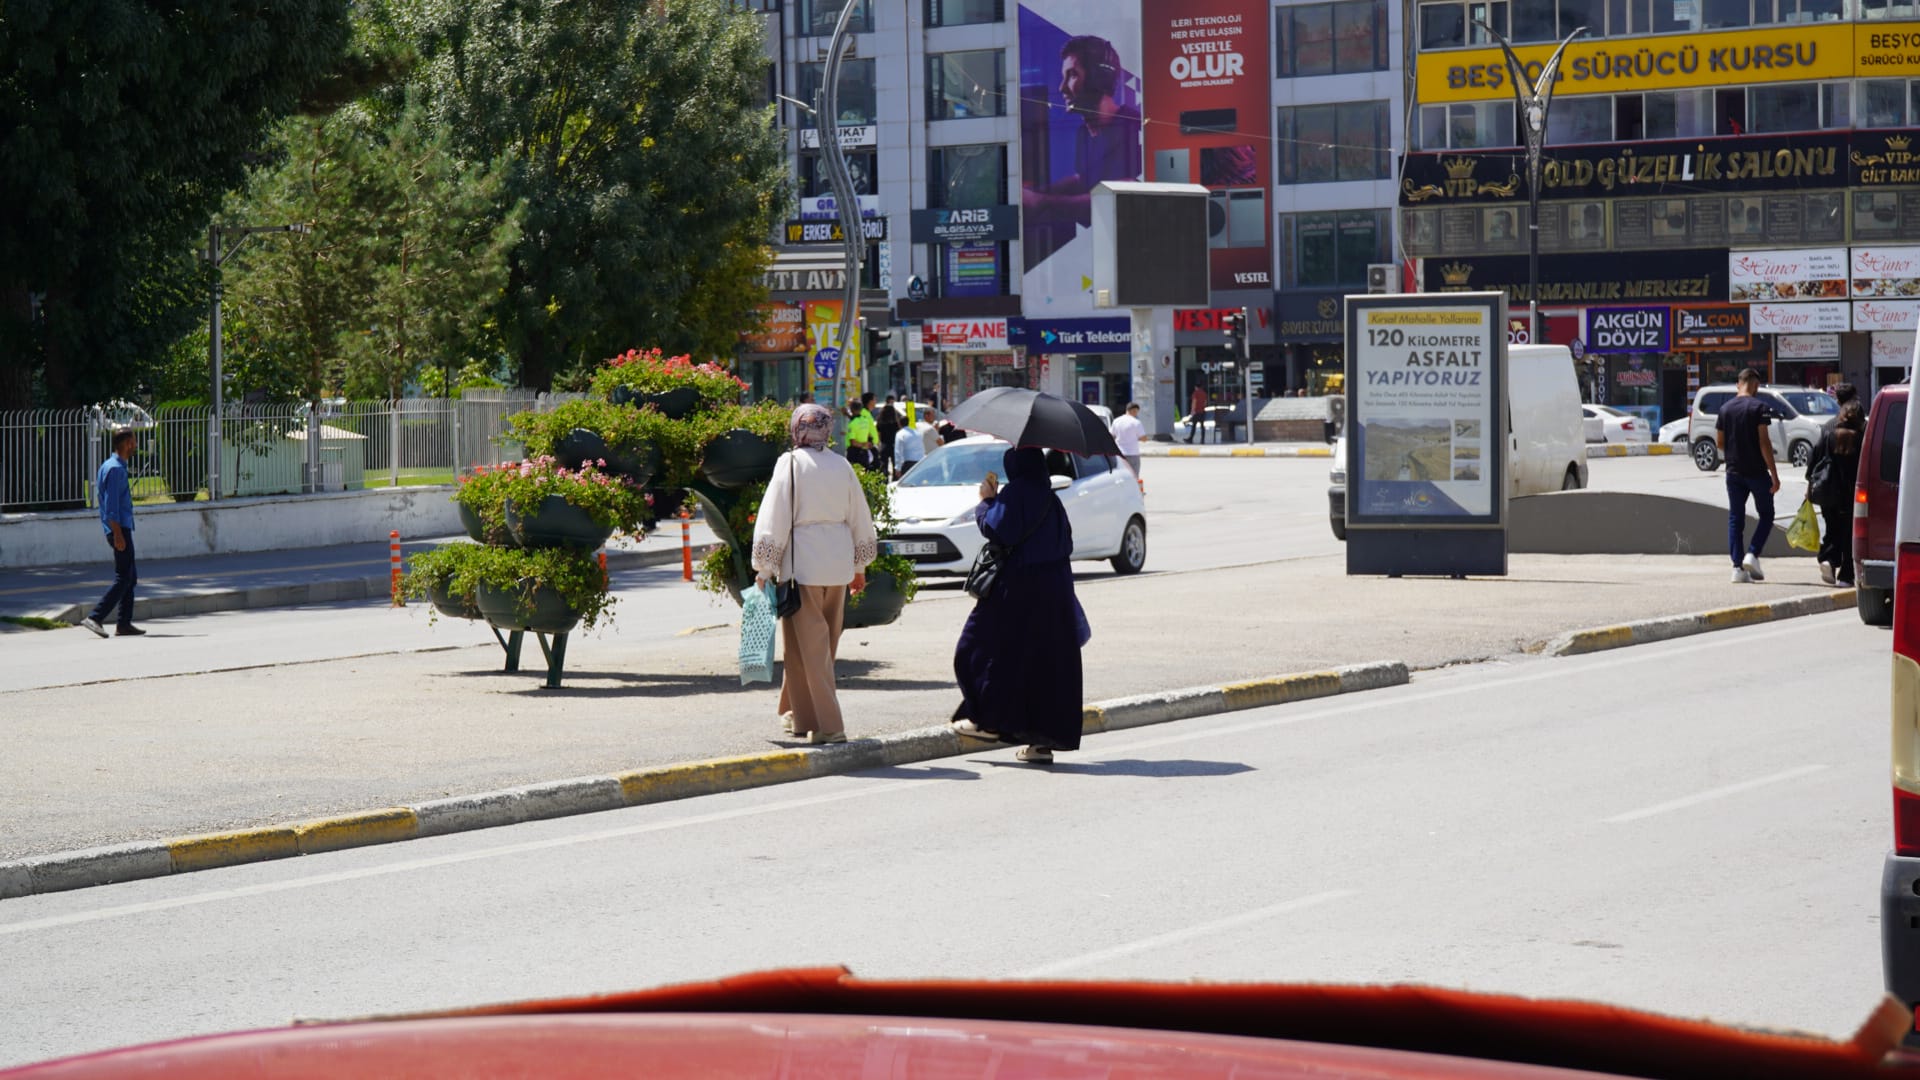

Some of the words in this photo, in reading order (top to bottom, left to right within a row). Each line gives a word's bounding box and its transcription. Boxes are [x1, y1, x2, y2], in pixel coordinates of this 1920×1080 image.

[1171, 31, 1188, 39] HER
[1189, 28, 1206, 38] EVE
[1181, 40, 1233, 54] VESTEL'LE
[1169, 52, 1244, 80] OLUR
[1572, 44, 1699, 81] SÜRÜCÜ
[1709, 41, 1817, 72] KURSU
[1861, 54, 1904, 65] SÜRÜCÜ
[1885, 152, 1912, 164] VIP
[1598, 144, 1722, 190] GÜZELLİK
[1726, 147, 1836, 178] SALONU
[1861, 166, 1887, 183] CİLT
[1444, 179, 1477, 197] VIP
[788, 224, 803, 241] VIP
[804, 224, 832, 241] ERKEK
[1234, 272, 1269, 283] VESTEL
[1624, 274, 1710, 297] MERKEZİ
[1400, 313, 1436, 323] Mahalle
[1594, 310, 1663, 329] AKGÜN
[1057, 331, 1084, 344] Türk
[1368, 329, 1404, 347] 120
[1598, 330, 1659, 346] DÖVİZ
[820, 351, 839, 360] WC
[1406, 351, 1481, 367] ASFALT
[1366, 371, 1481, 385] YAPIYORUZ
